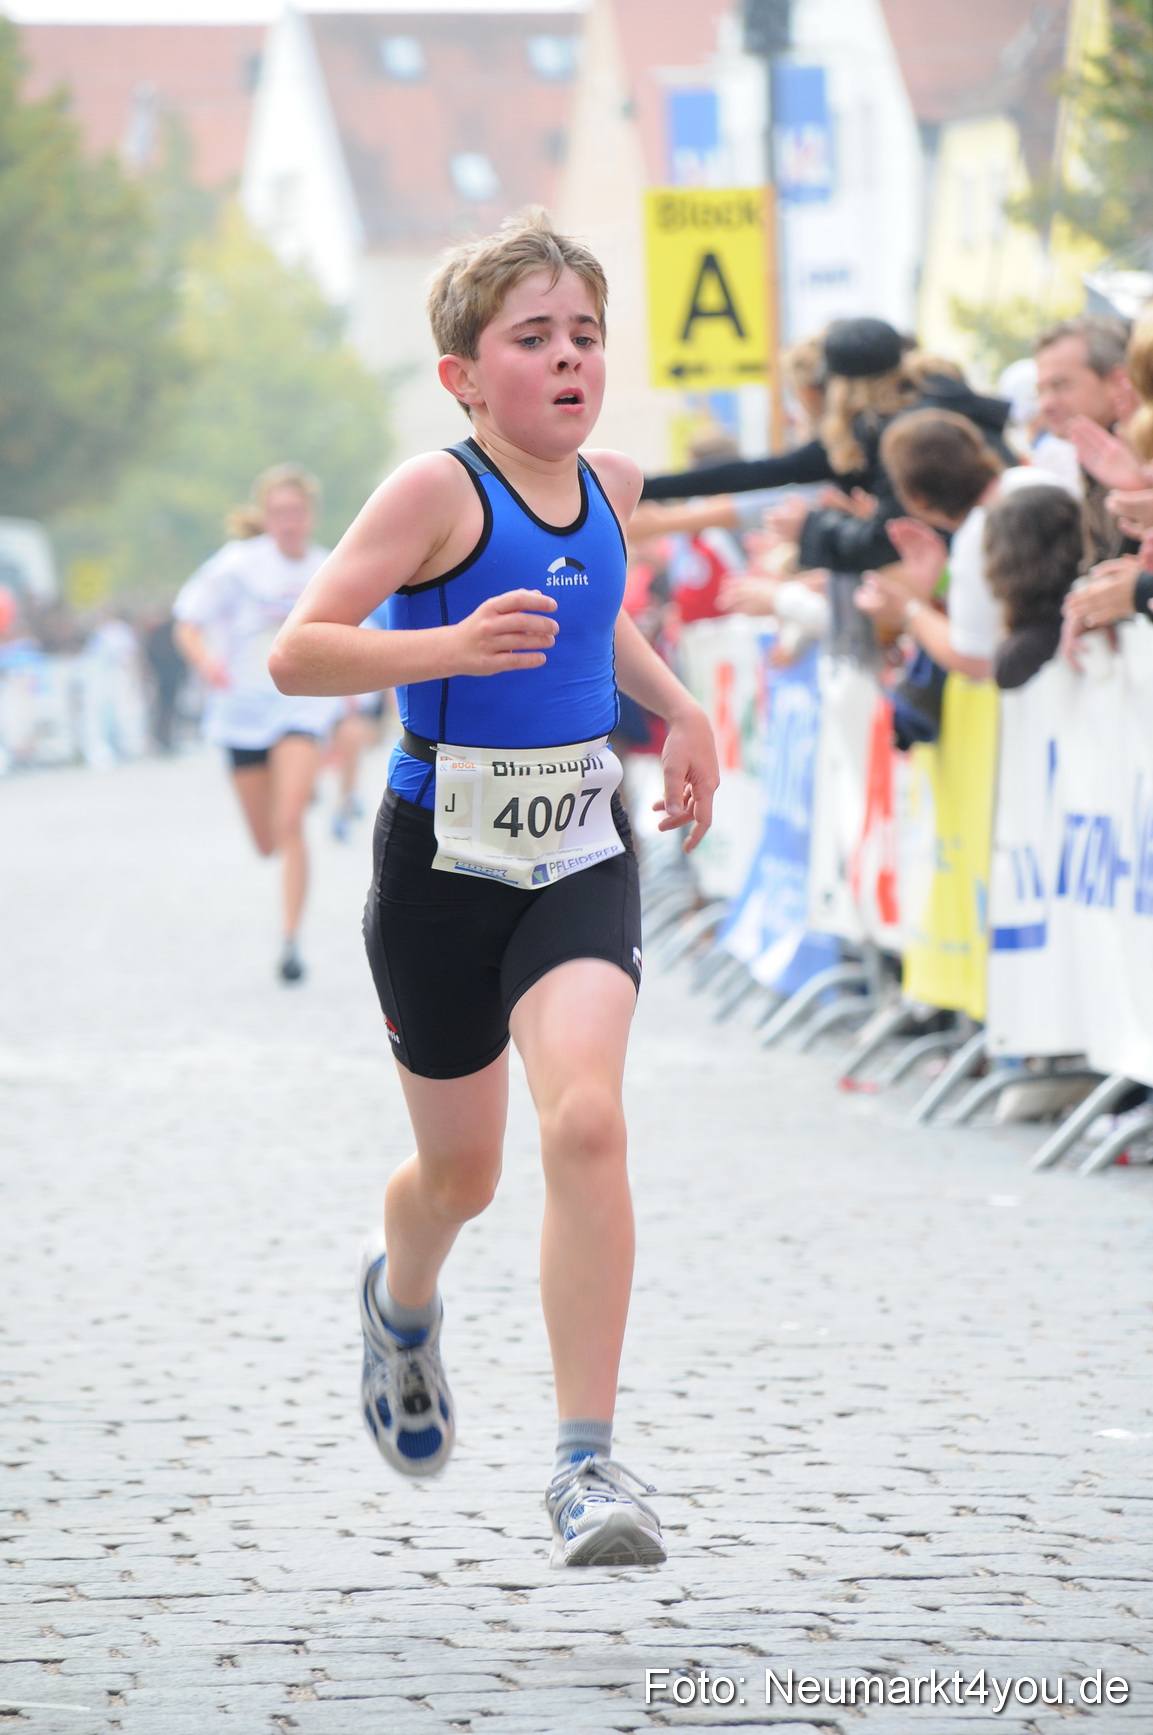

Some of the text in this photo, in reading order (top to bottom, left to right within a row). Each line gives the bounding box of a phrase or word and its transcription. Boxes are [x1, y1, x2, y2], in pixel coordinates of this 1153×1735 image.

[679, 250, 746, 342] A
[546, 573, 589, 587] skinfit
[445, 793, 456, 813] J
[493, 787, 603, 839] 4007
